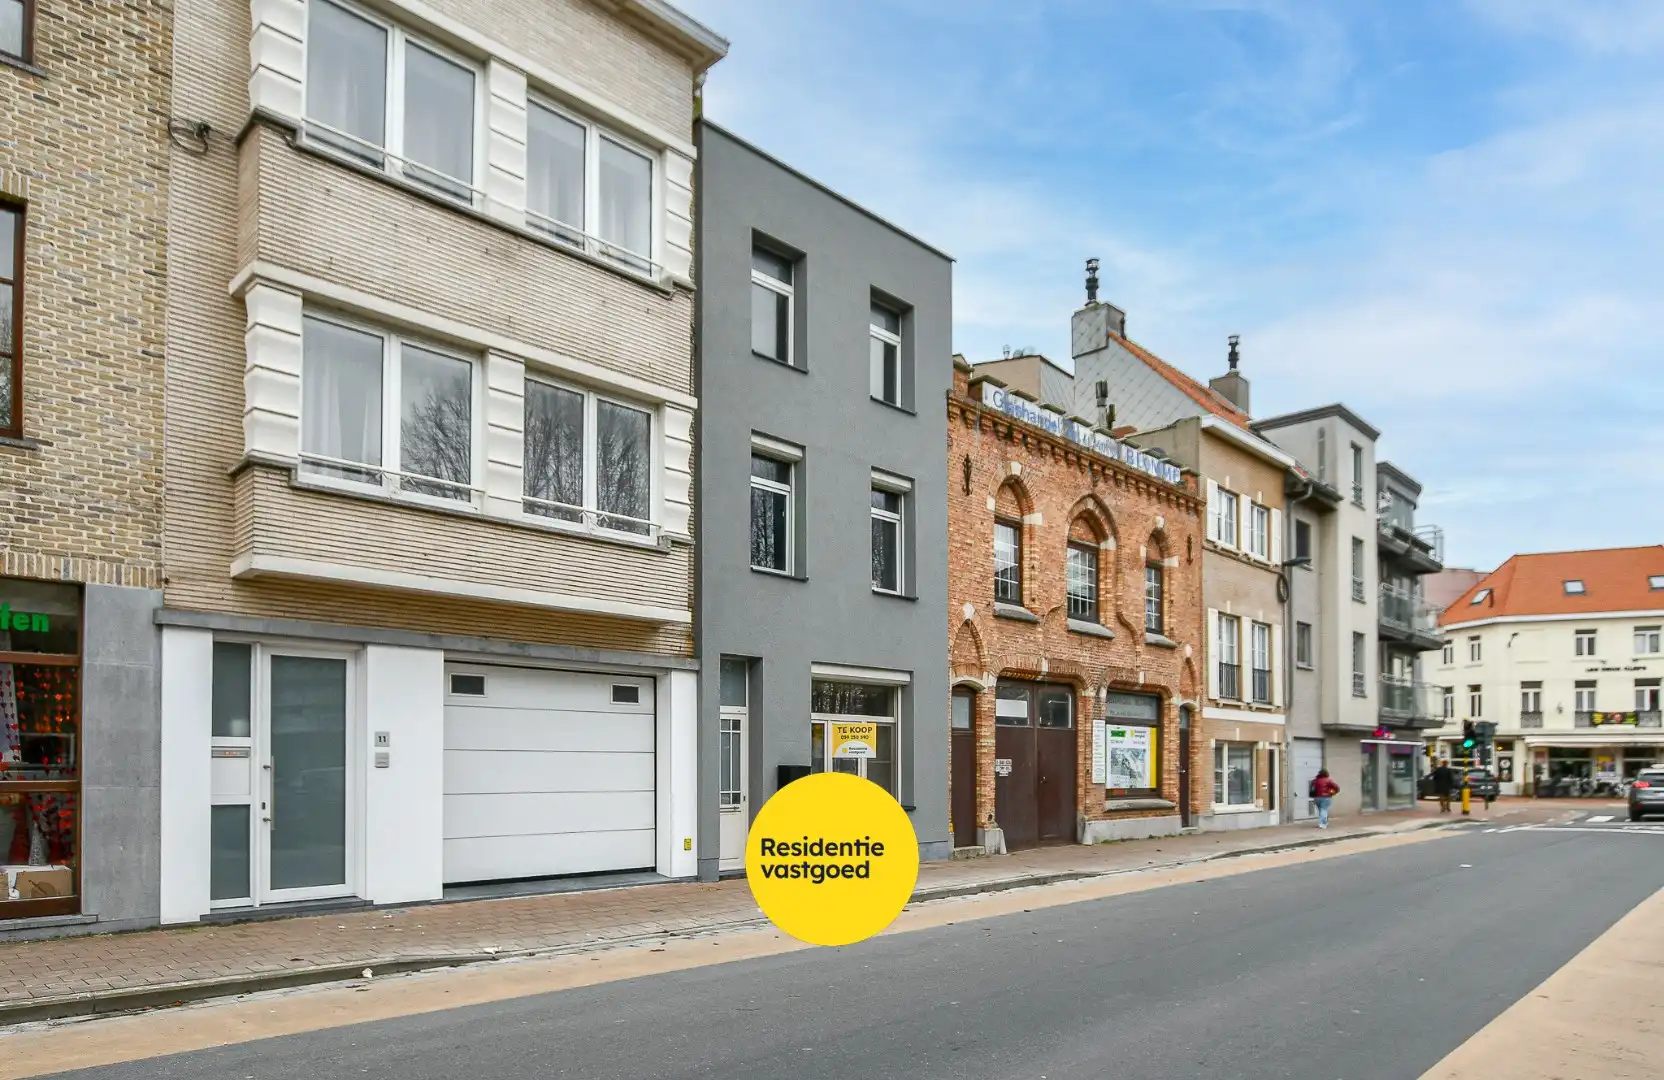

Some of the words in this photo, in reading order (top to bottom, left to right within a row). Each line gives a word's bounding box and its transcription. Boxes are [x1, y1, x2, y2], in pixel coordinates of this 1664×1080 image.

[837, 726, 848, 734] TE
[849, 726, 873, 734] KOOP
[378, 735, 387, 743] 11
